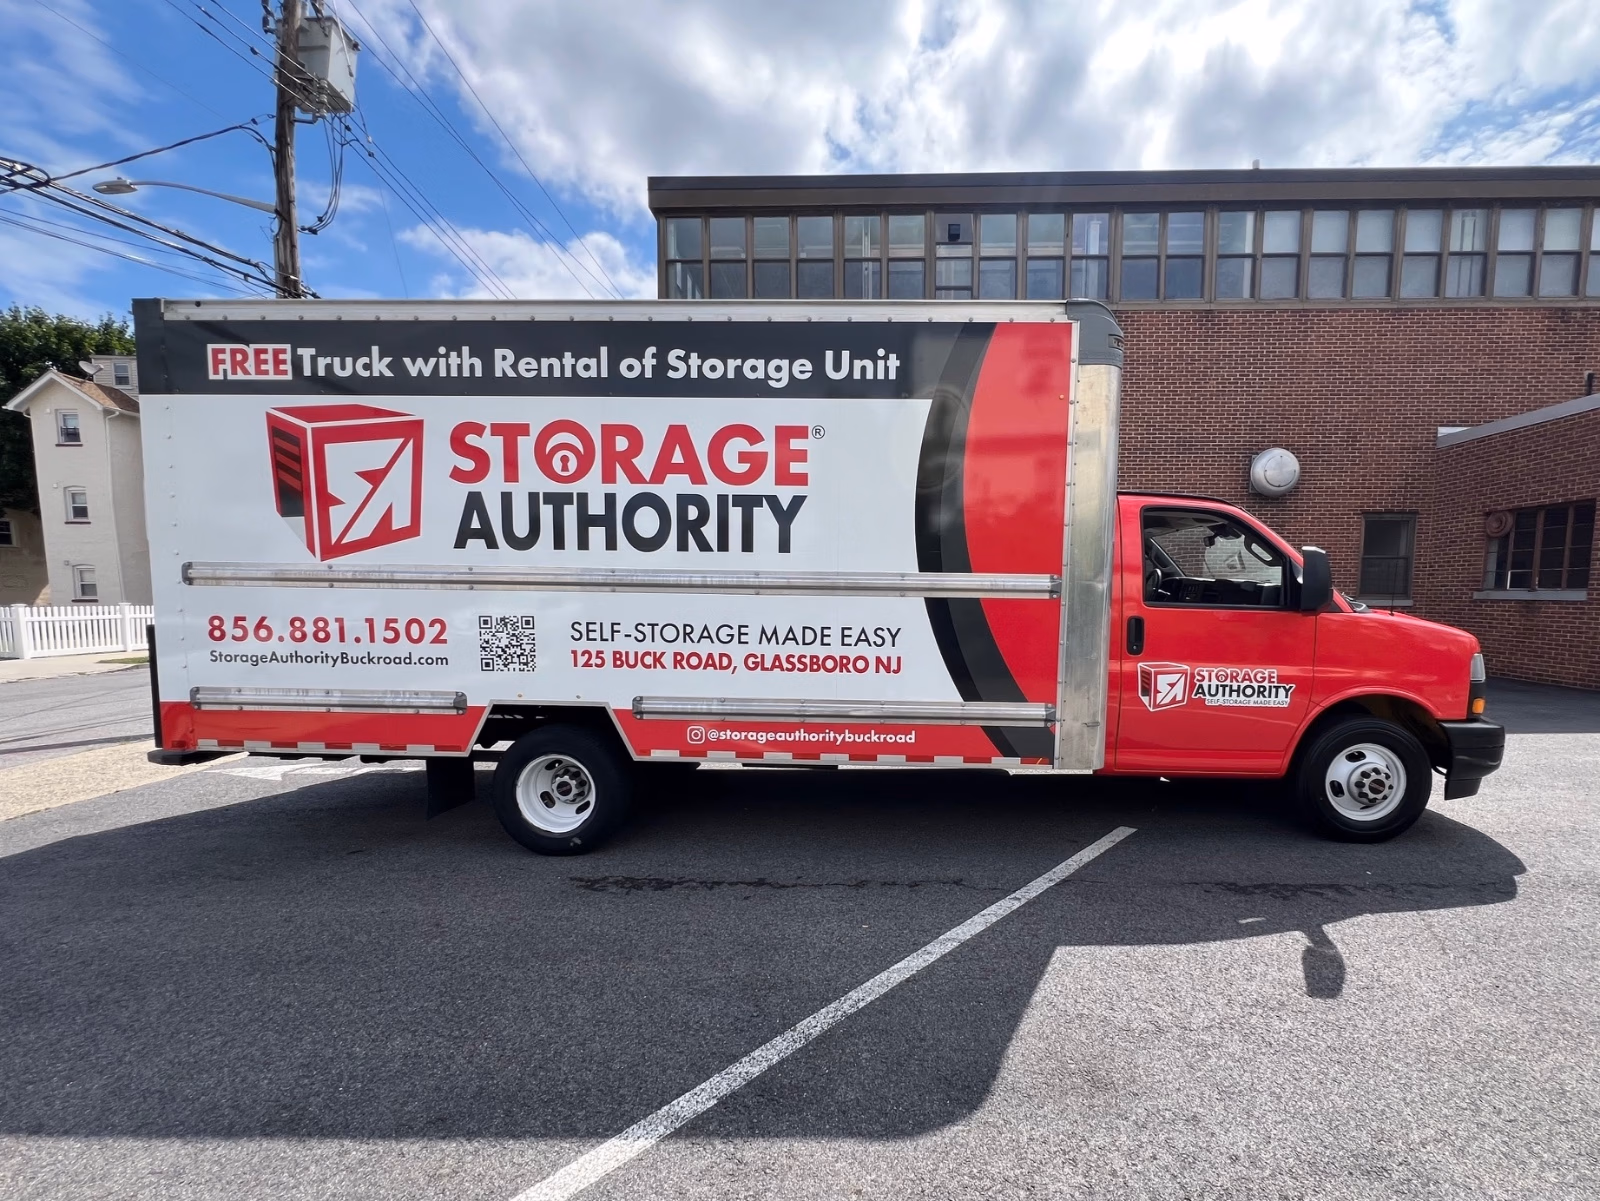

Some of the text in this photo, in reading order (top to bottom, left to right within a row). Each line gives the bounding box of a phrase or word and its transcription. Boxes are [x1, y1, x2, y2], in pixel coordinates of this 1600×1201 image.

[208, 345, 900, 388] FREE Truck with Rental of Storage Unit
[453, 491, 808, 554] AUTHORITY
[208, 615, 449, 645] 856.881.1502
[570, 621, 902, 648] SELF-STORAGE MADE EASY
[209, 650, 449, 668] StorageAuthorityBuckroad.com
[570, 649, 902, 675] 125 BUCK ROAD, GLASSBORO NJ
[1195, 669, 1276, 684] STORAGE
[1193, 684, 1294, 698] AUTHORITY
[707, 728, 916, 745] @storageauthoritybuckroad
